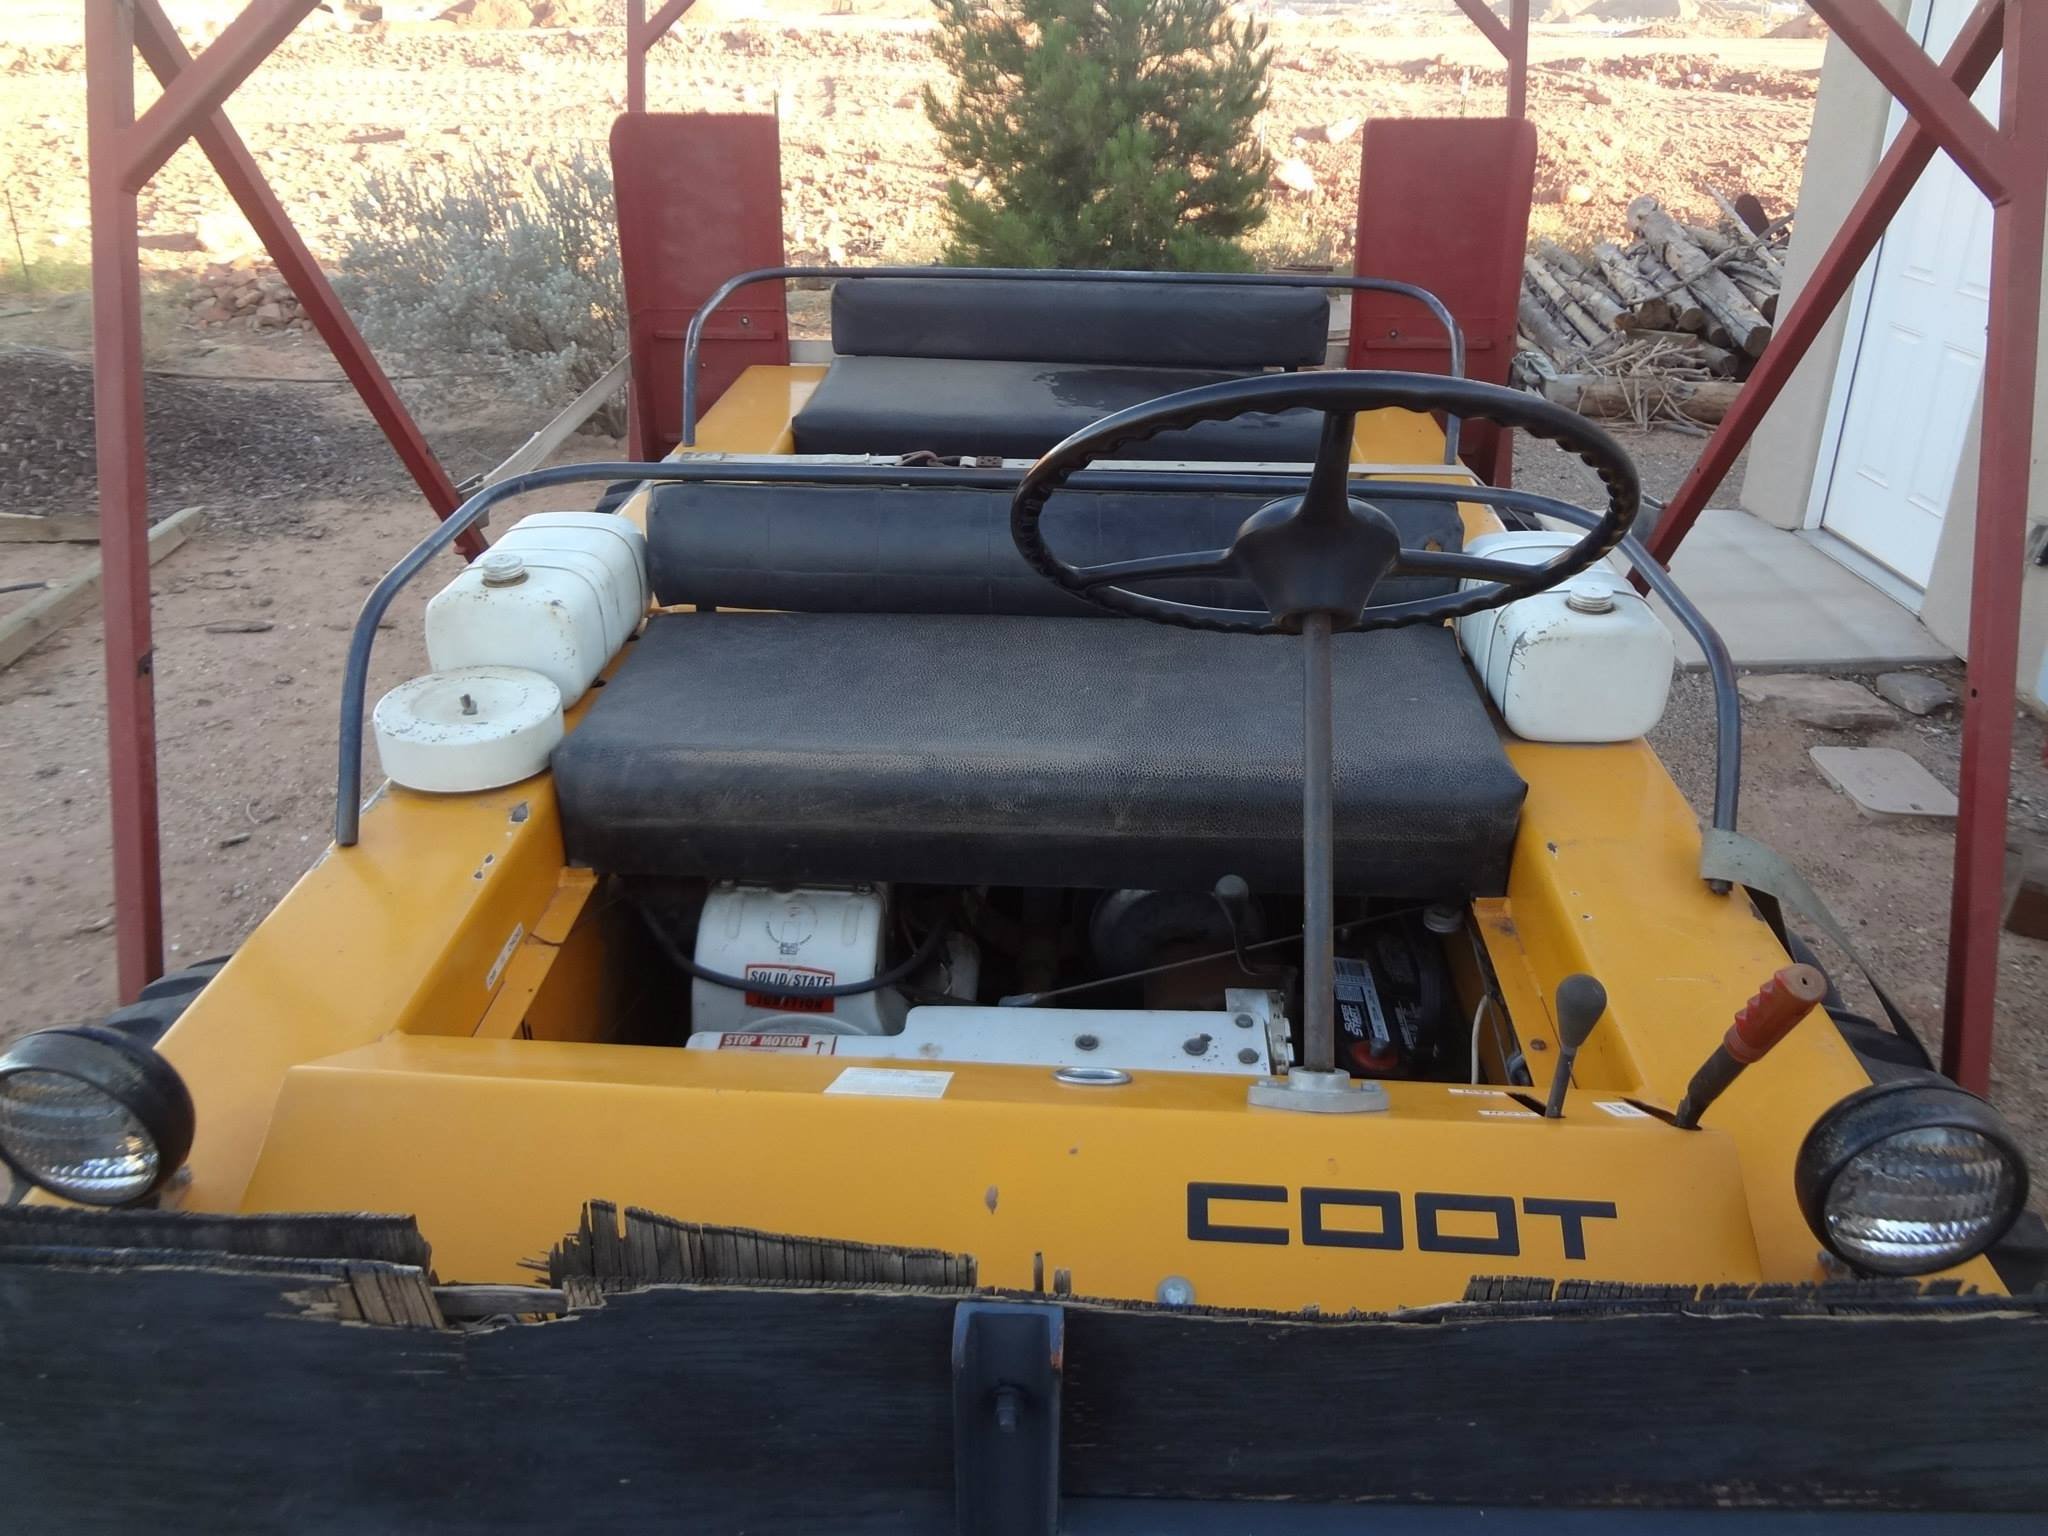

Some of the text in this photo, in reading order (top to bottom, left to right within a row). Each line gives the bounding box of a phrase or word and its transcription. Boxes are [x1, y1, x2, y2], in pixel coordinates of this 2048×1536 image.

[793, 974, 832, 988] STATE
[1341, 1003, 1352, 1032] SUPER
[1348, 1004, 1363, 1037] START
[724, 1034, 805, 1047] STOP MOTOR
[1187, 1181, 1617, 1260] COOT
